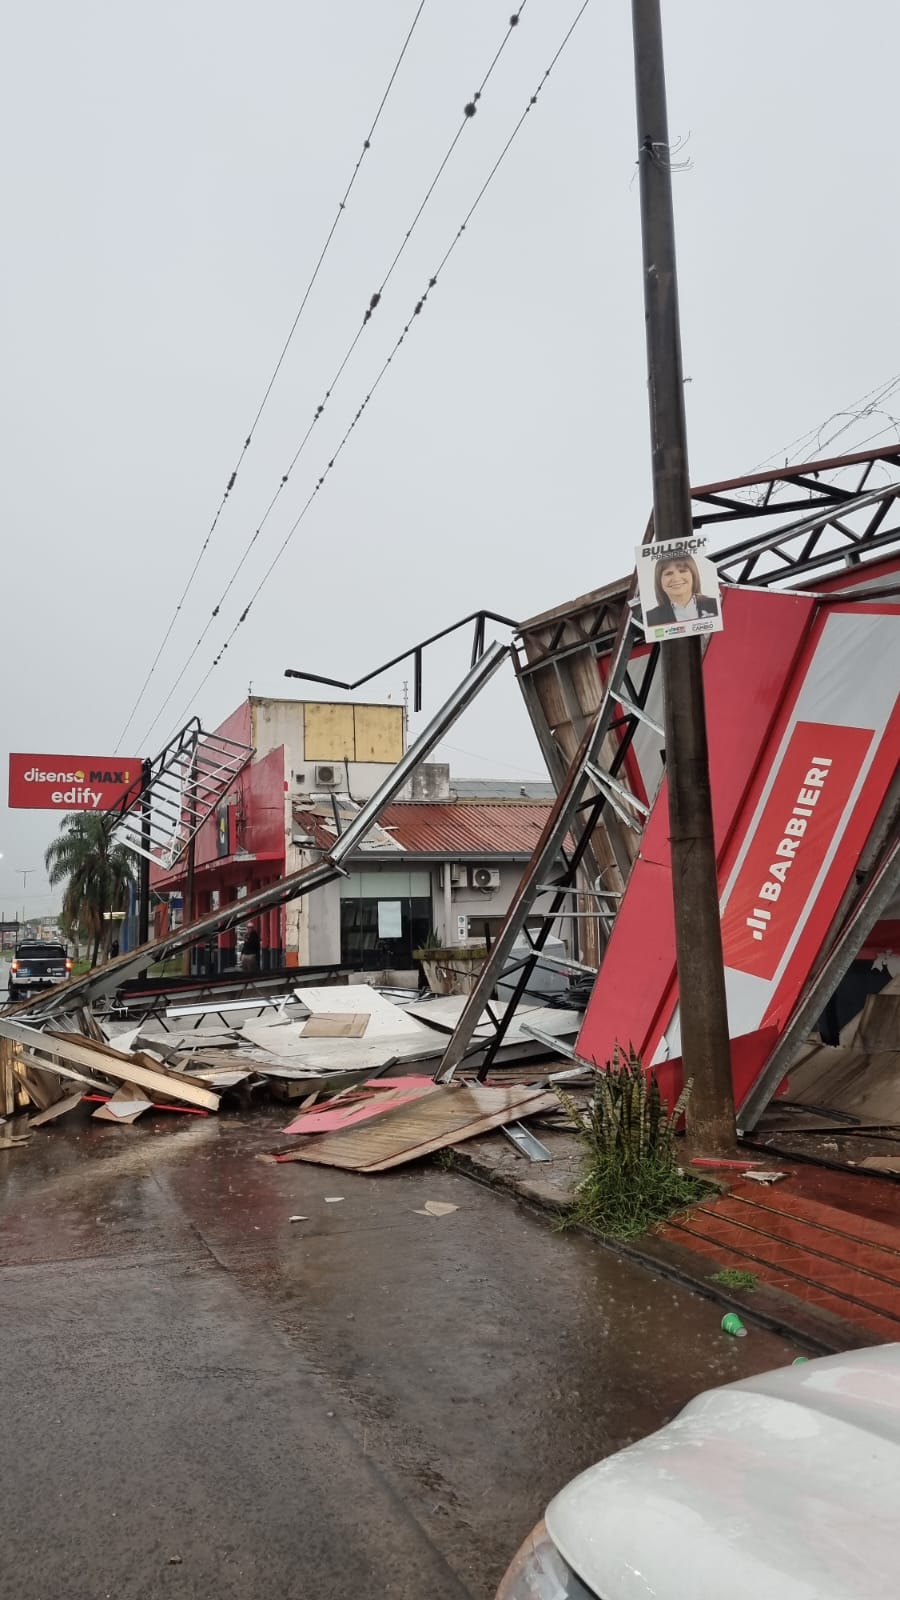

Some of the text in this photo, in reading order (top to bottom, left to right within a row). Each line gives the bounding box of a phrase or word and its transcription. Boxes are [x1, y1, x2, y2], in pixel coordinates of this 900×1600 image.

[642, 538, 707, 558] BULLRICH
[89, 771, 130, 783] MAX!
[51, 787, 103, 807] edify
[758, 756, 833, 902] BARBIERI
